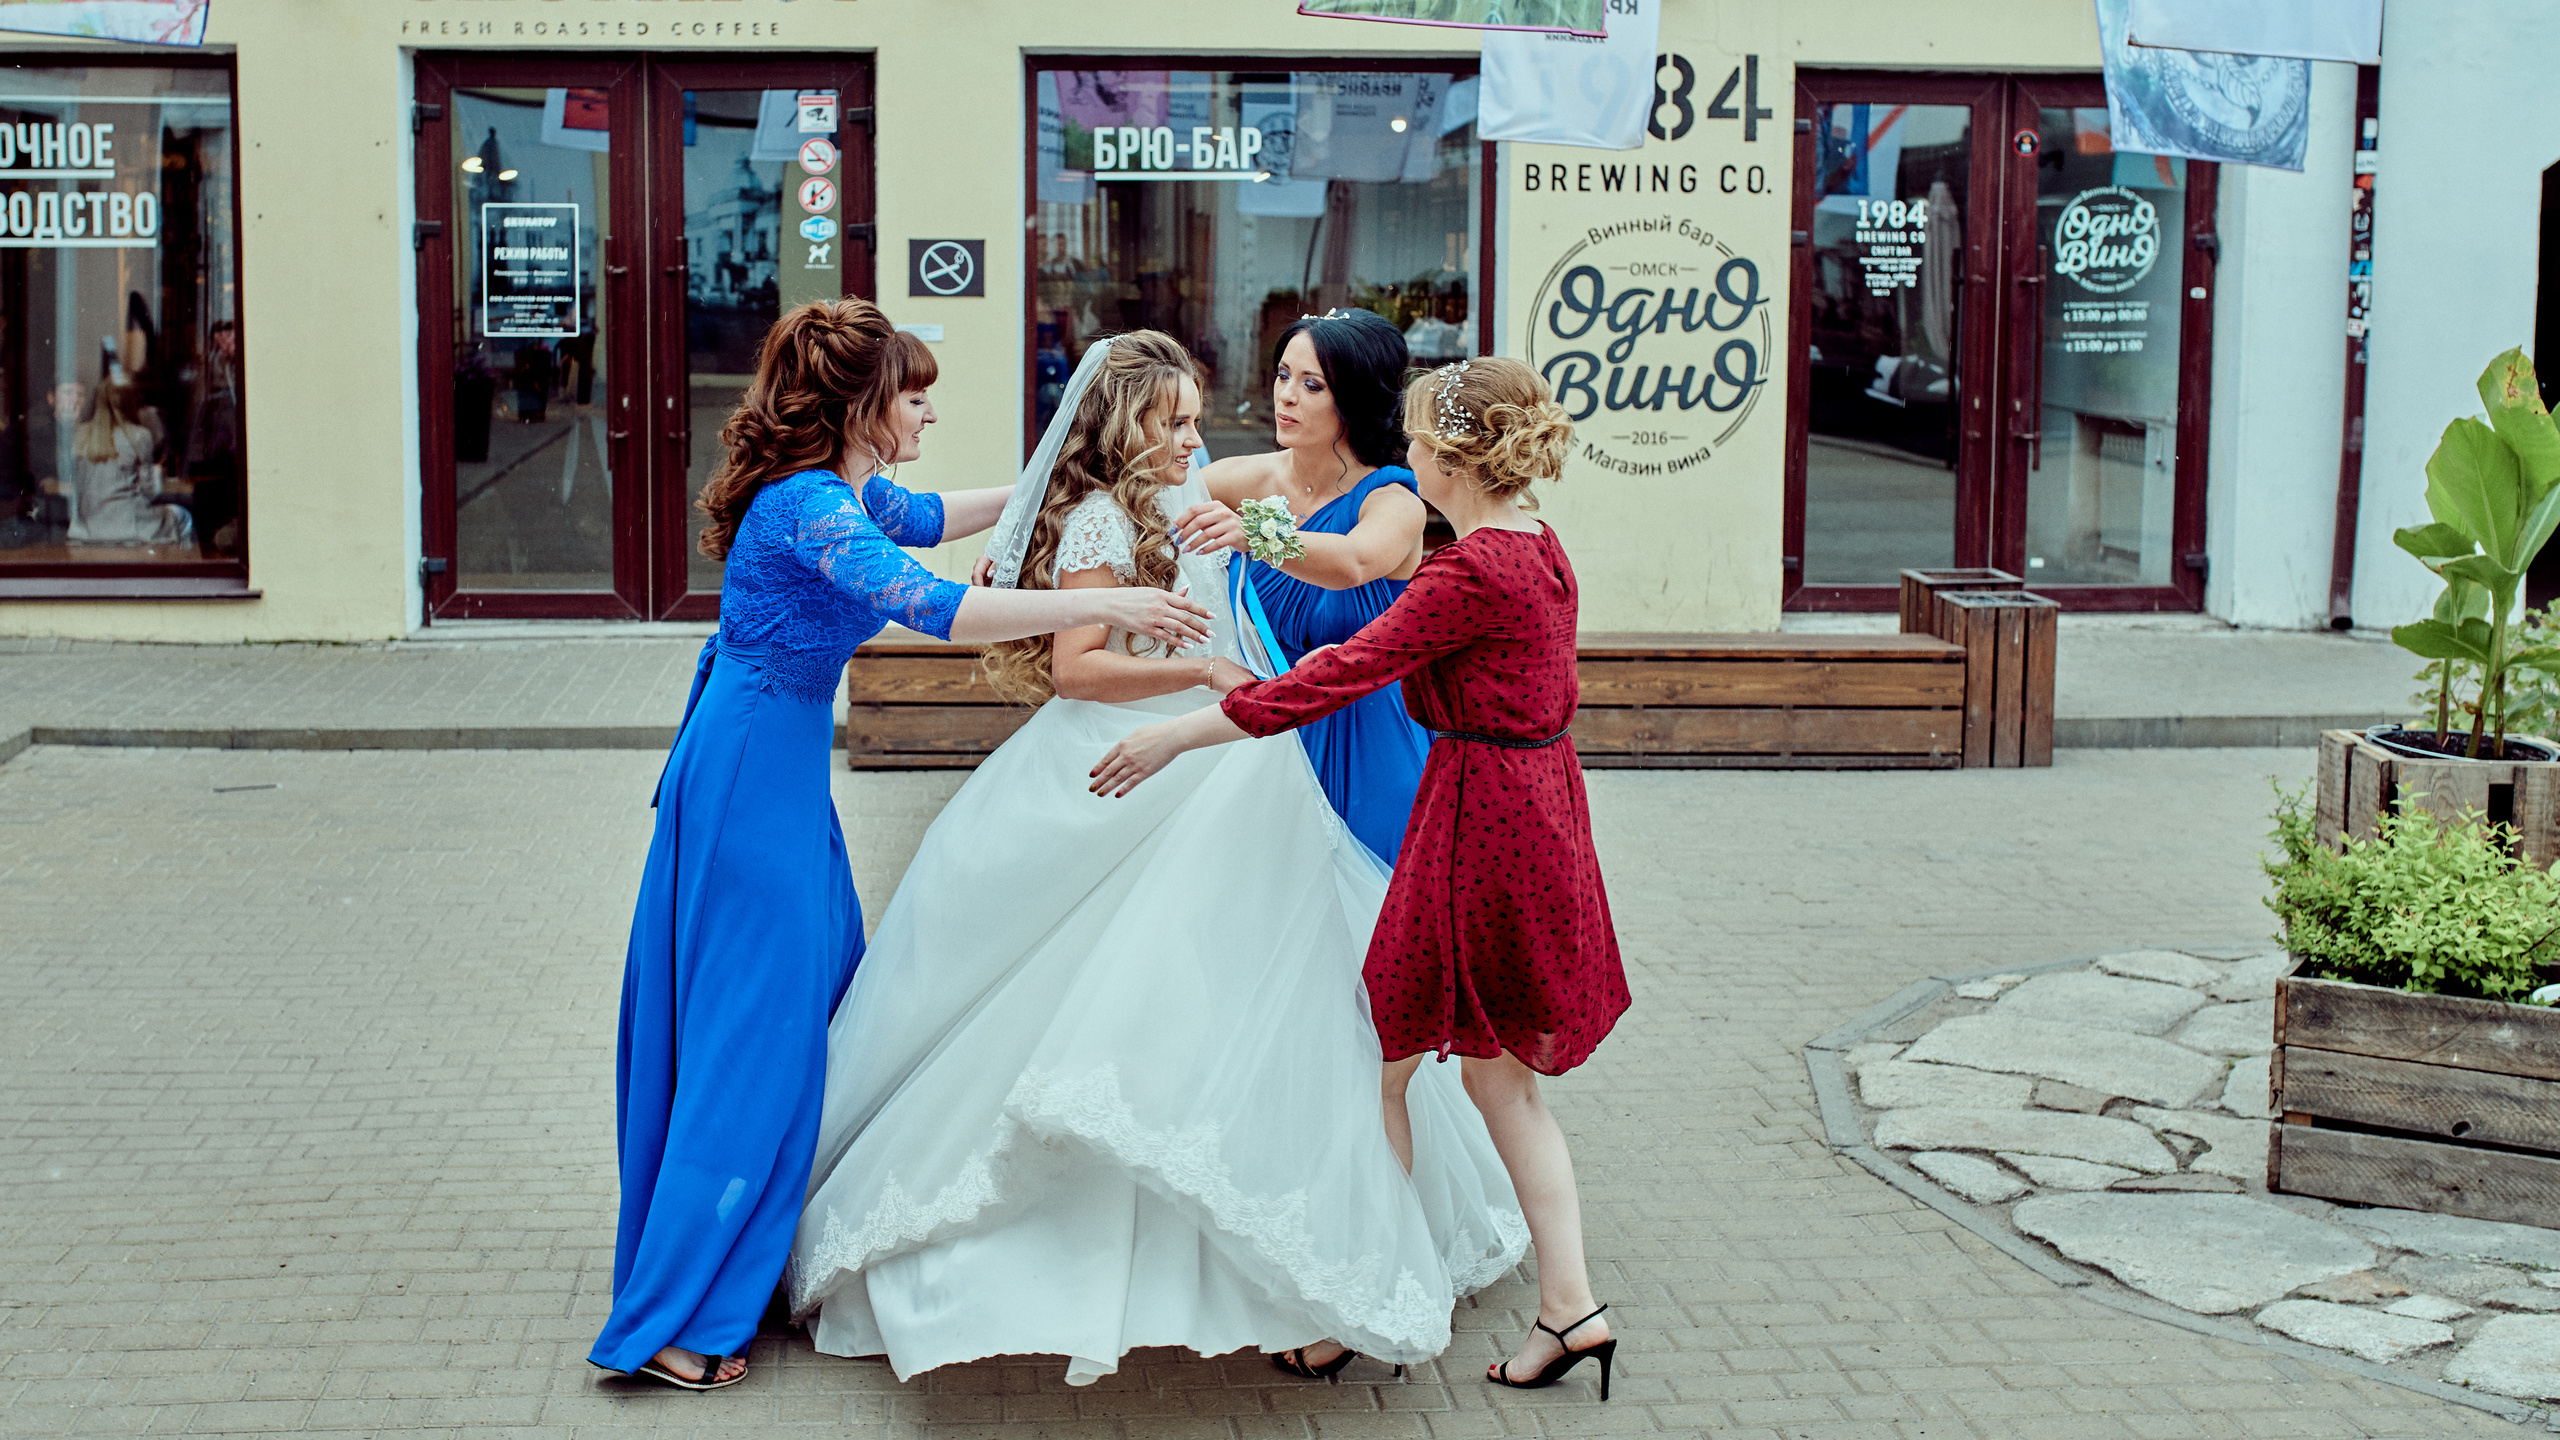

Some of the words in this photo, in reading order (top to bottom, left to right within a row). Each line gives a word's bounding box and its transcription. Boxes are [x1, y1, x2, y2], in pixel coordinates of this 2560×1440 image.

[402, 20, 492, 36] FRESH
[514, 21, 650, 36] ROASTED
[671, 21, 780, 36] COFFEE
[1094, 126, 1263, 170] БРЮ-БАР
[1525, 164, 1697, 193] BREWING
[1720, 164, 1772, 194] CO.
[1856, 199, 1929, 229] 1984
[1587, 214, 1672, 245] Винный
[1678, 218, 1714, 247] бар
[1855, 231, 1908, 243] BREWING
[494, 247, 529, 261] РЕЖИМ
[530, 247, 569, 261] РАБОТЫ
[1629, 262, 1678, 277] ОМСК
[2072, 310, 2101, 322] 15:00
[2074, 340, 2103, 352] 15:00
[1631, 431, 1668, 446] 2016
[1582, 443, 1662, 477] Магазин
[1667, 446, 1711, 475] вина
